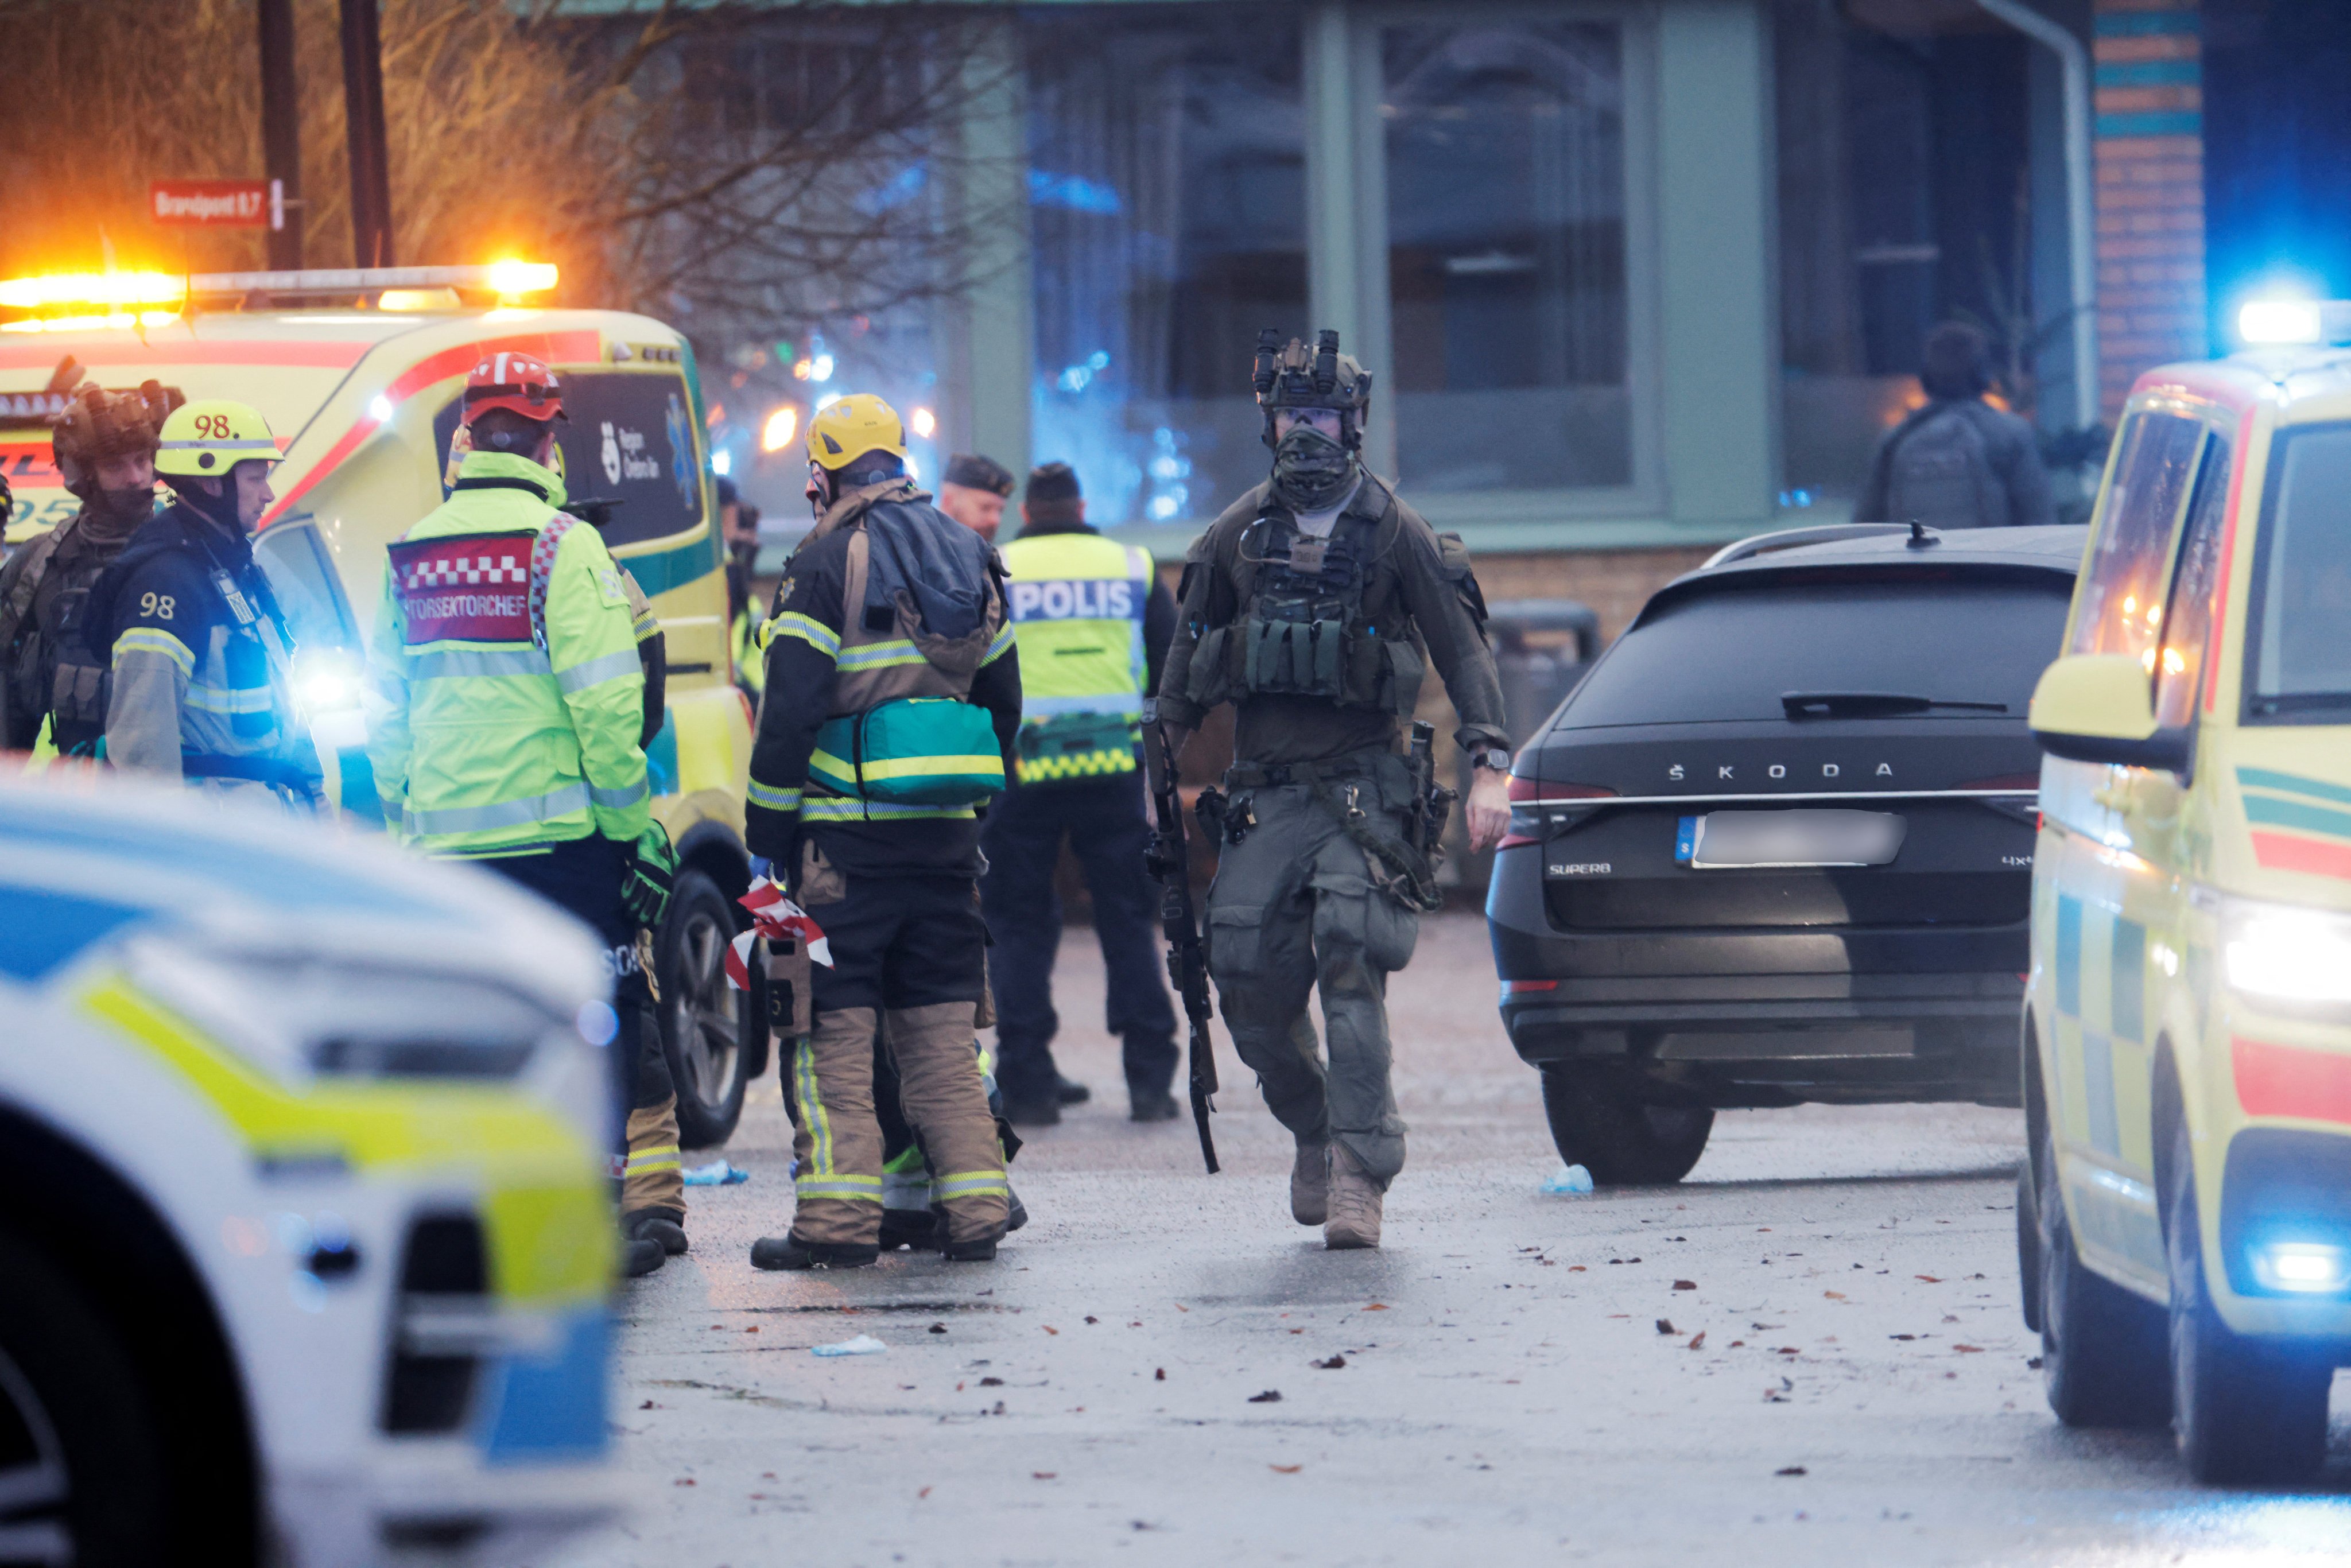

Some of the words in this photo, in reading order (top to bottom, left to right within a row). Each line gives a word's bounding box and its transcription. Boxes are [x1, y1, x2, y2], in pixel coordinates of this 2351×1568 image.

[195, 414, 230, 439] 98
[140, 592, 176, 620] 98
[405, 595, 526, 620] TORSEKTORCHEF
[1012, 581, 1132, 620] POLIS
[1669, 763, 1892, 781] ŠKODA
[1681, 842, 1690, 854] S
[1549, 863, 1612, 875] SUPERB
